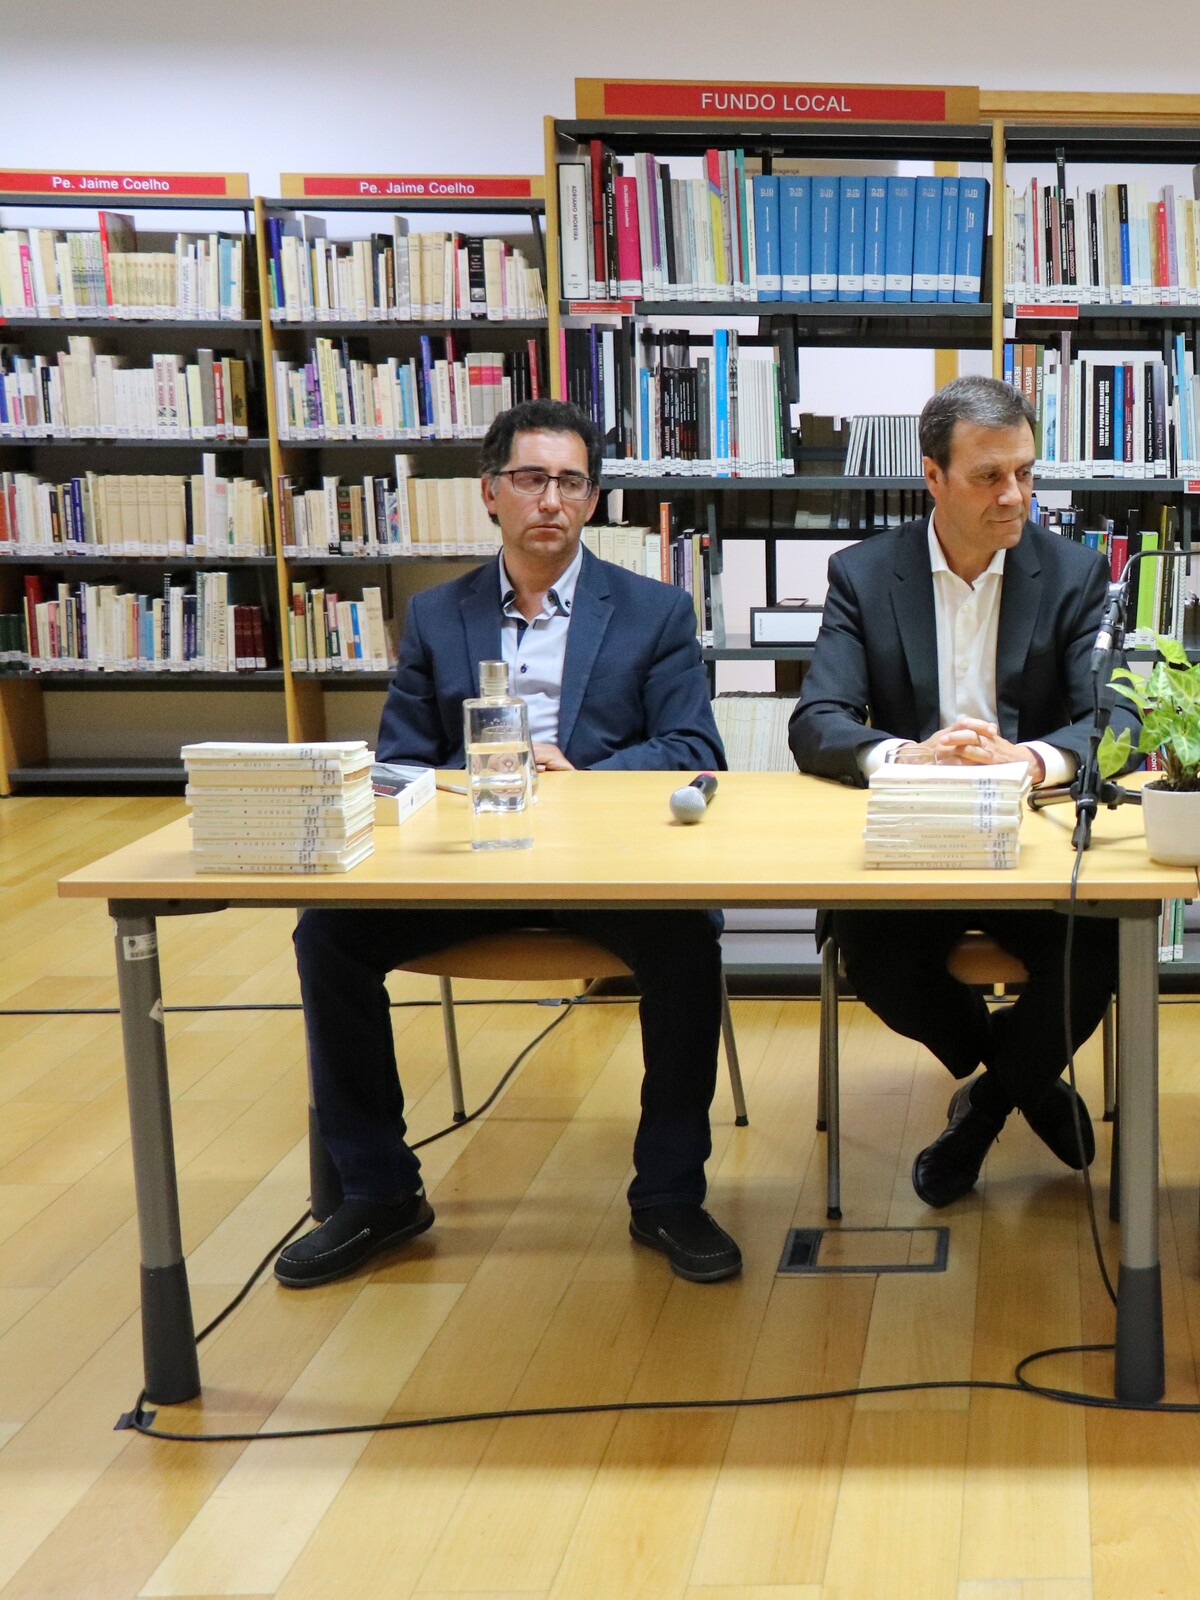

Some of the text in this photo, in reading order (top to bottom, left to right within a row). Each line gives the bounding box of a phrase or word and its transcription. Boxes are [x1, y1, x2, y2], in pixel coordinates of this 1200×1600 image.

[701, 93, 852, 113] FUNDO LOCAL
[51, 176, 170, 192] Pe. Jaime Coelho
[359, 181, 475, 195] Pe. Jaime Coelho
[218, 600, 226, 646] PORTUGAL
